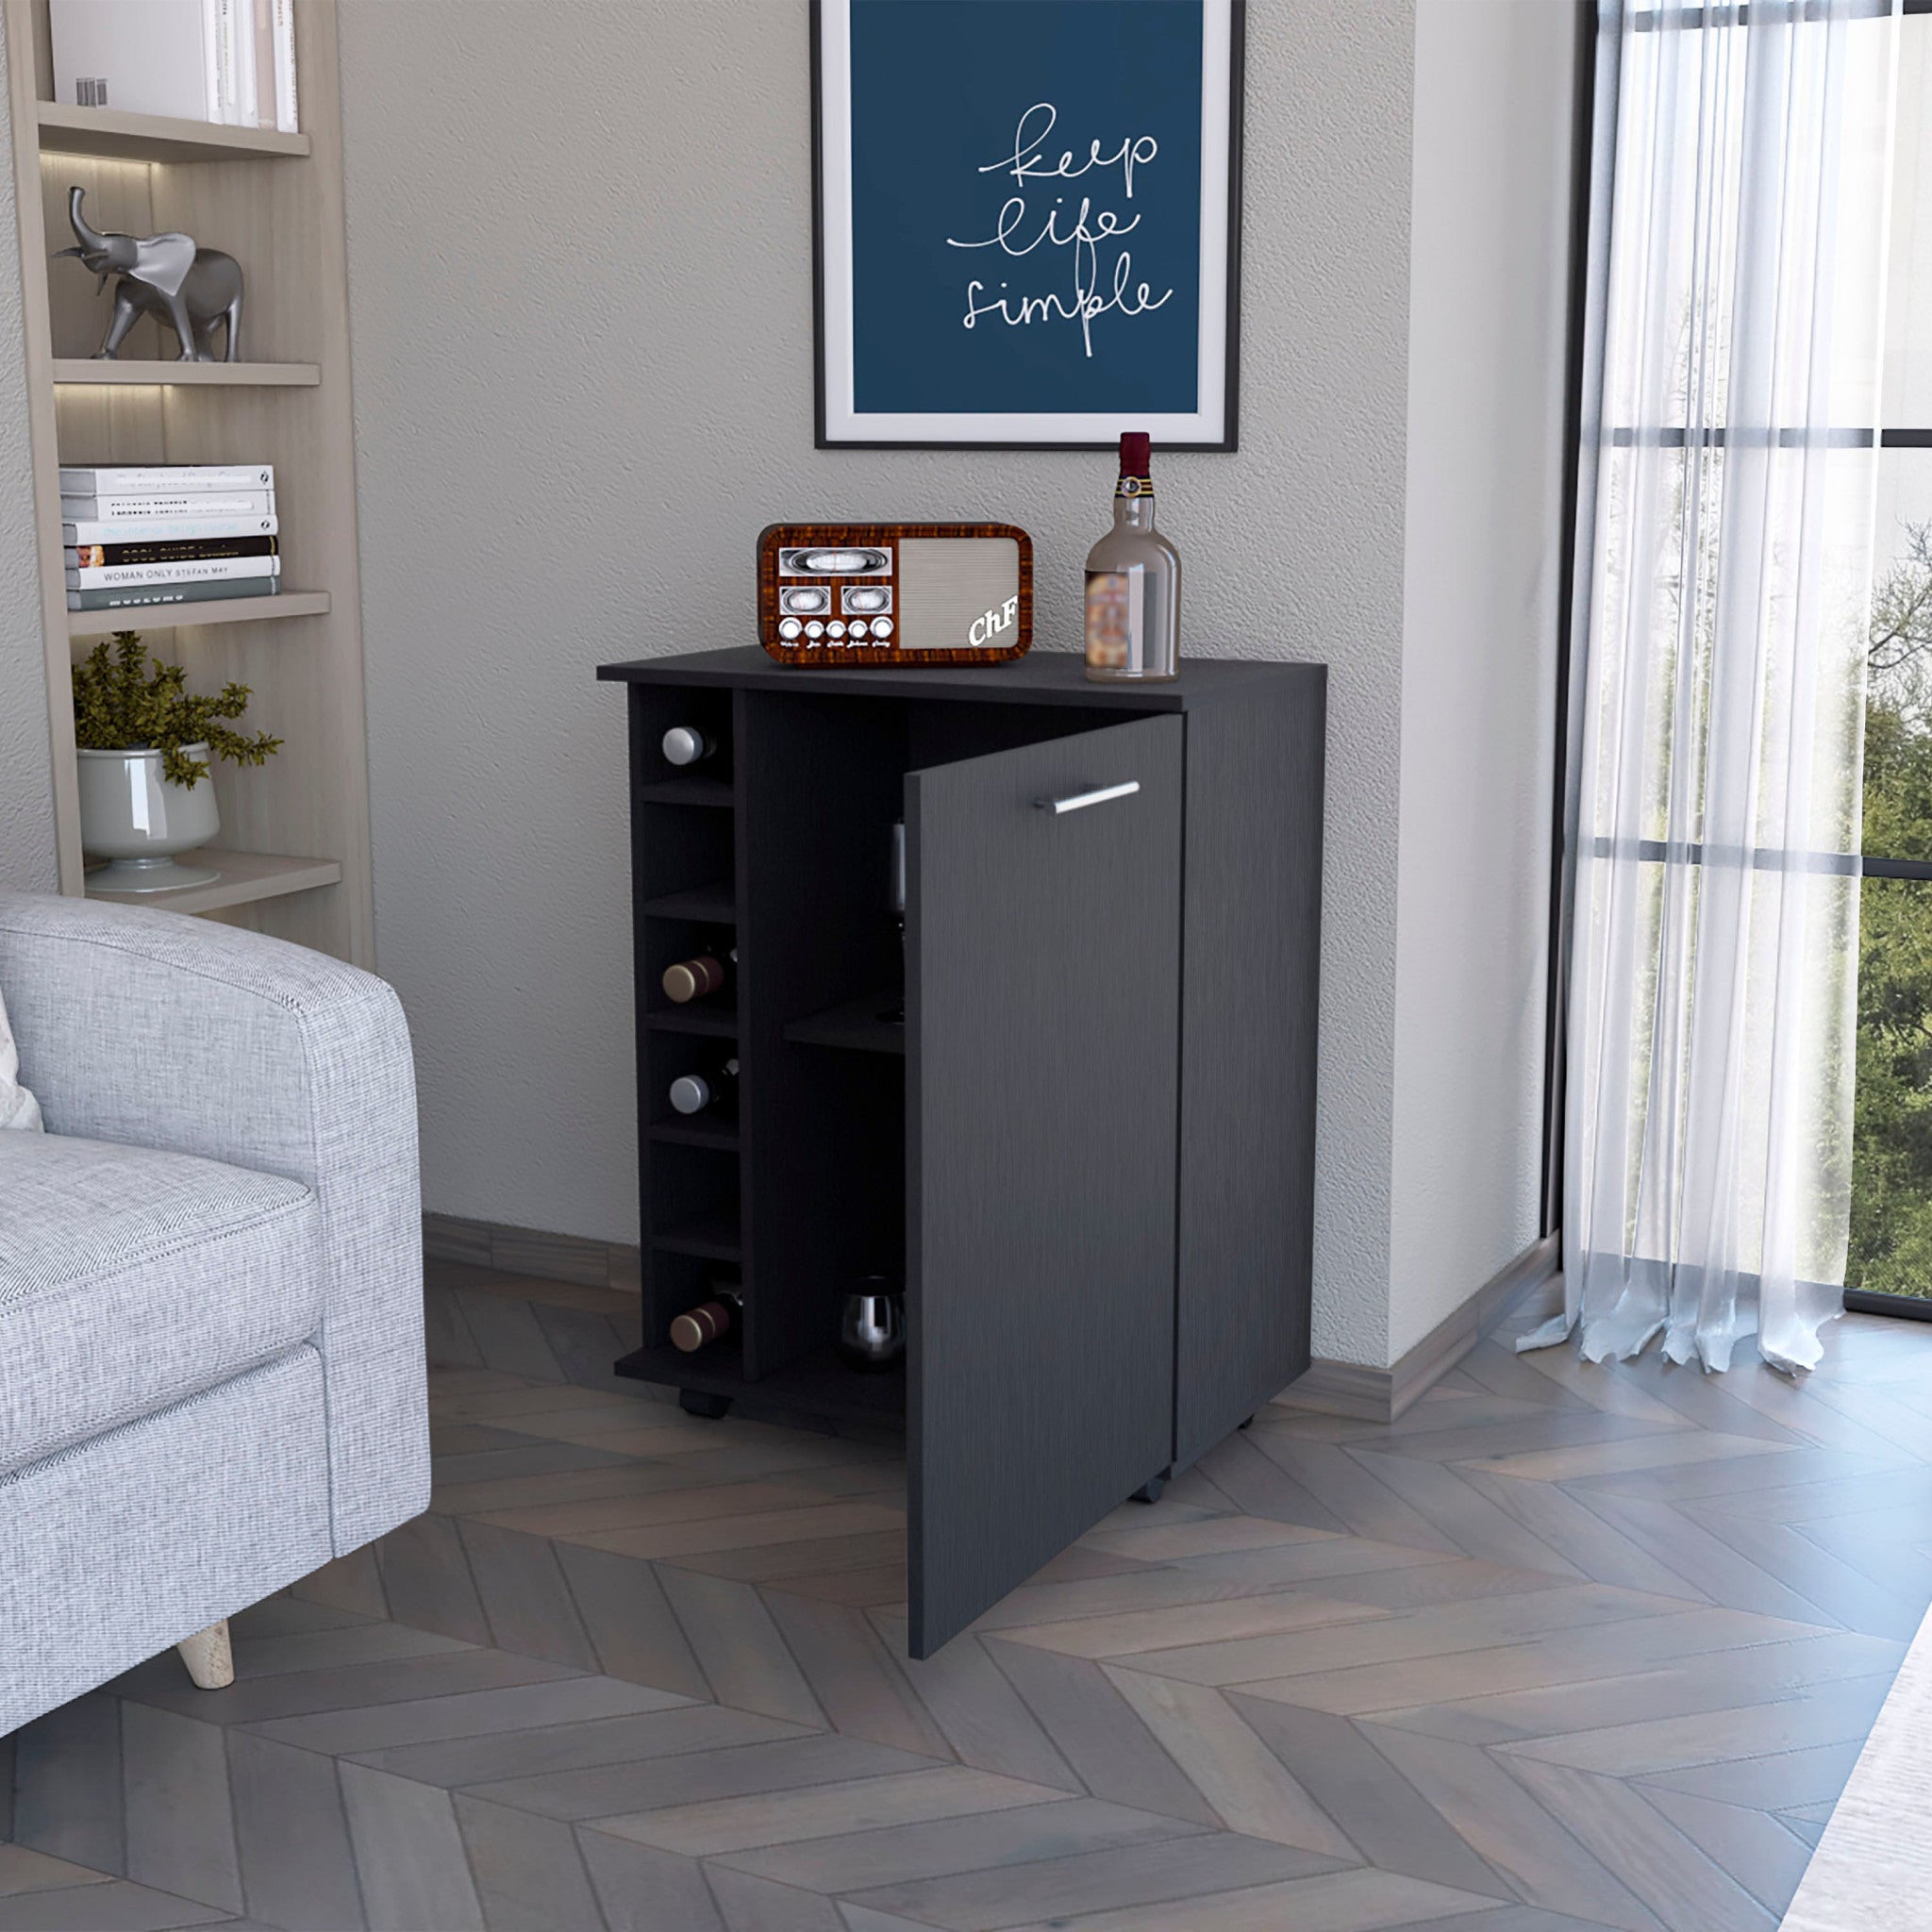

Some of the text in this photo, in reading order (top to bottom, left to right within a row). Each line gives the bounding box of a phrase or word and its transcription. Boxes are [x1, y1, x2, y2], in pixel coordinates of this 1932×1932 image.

[978, 103, 1158, 198] keep
[946, 197, 1141, 306] life
[963, 251, 1174, 358] simple
[104, 571, 143, 581] WOMAN
[146, 569, 173, 579] ONLY
[175, 568, 208, 577] STEFAN
[968, 594, 1019, 647] ChF
